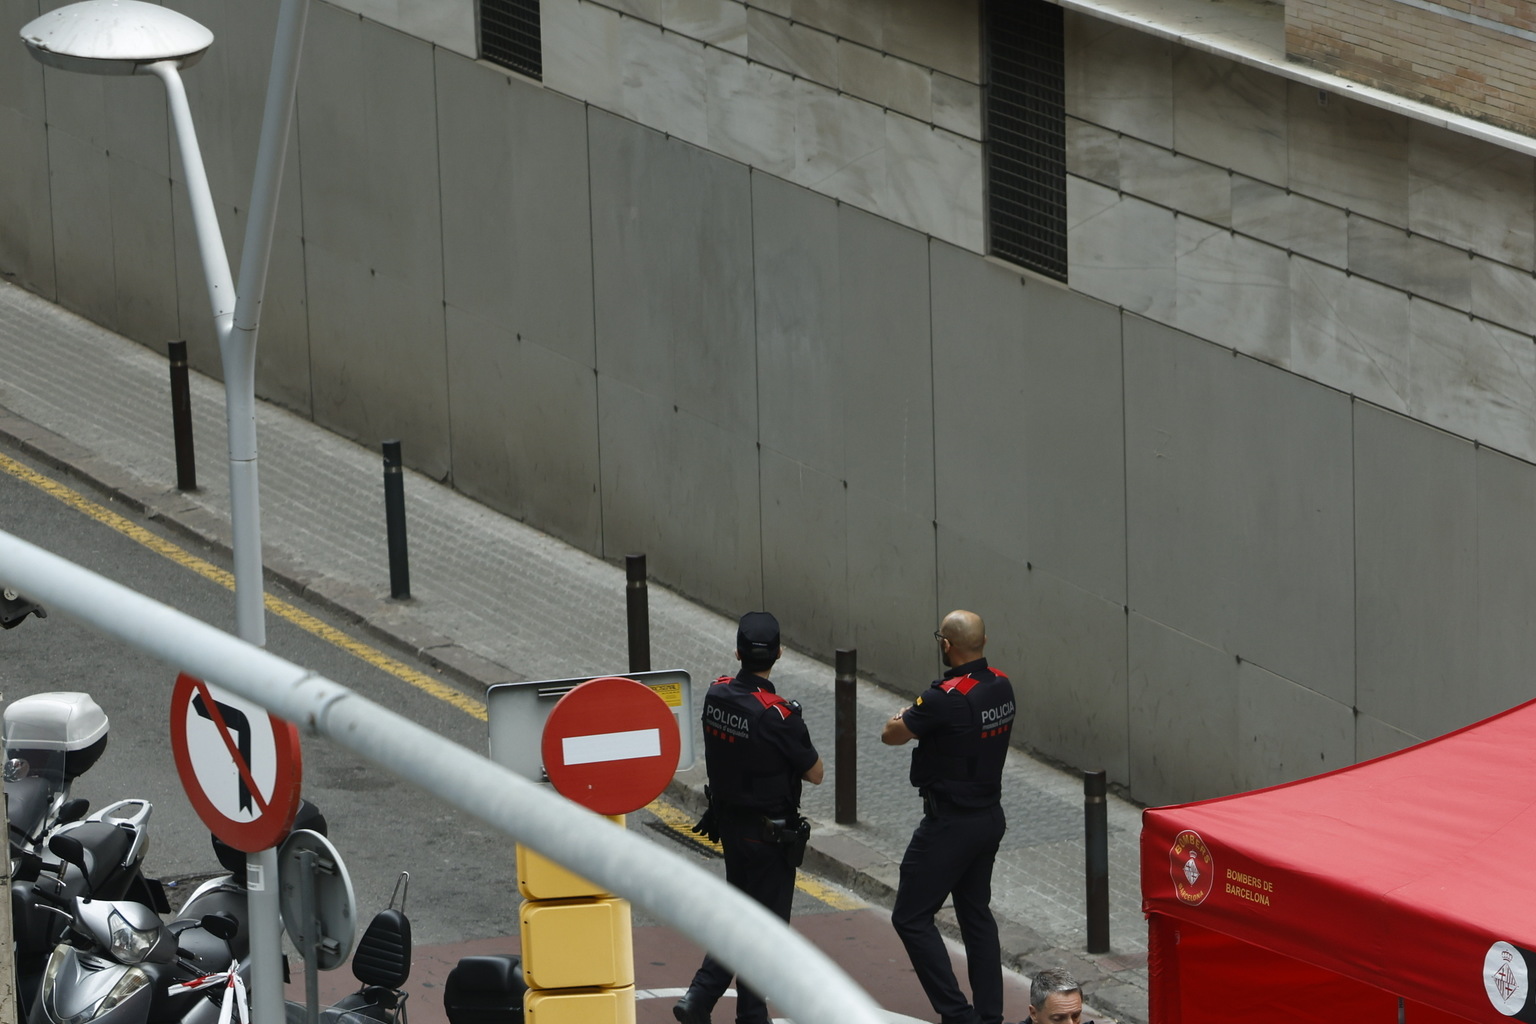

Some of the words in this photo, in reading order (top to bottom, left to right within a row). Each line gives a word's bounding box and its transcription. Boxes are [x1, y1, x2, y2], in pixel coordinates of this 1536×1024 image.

[707, 704, 749, 731] POLICIA
[981, 700, 1015, 723] POLICIA
[1174, 834, 1211, 864] BOMBERS
[1178, 883, 1204, 901] BARCELONA
[1226, 868, 1262, 889] BOMBERS
[1263, 882, 1273, 893] DE
[1225, 883, 1270, 906] BARCELONA
